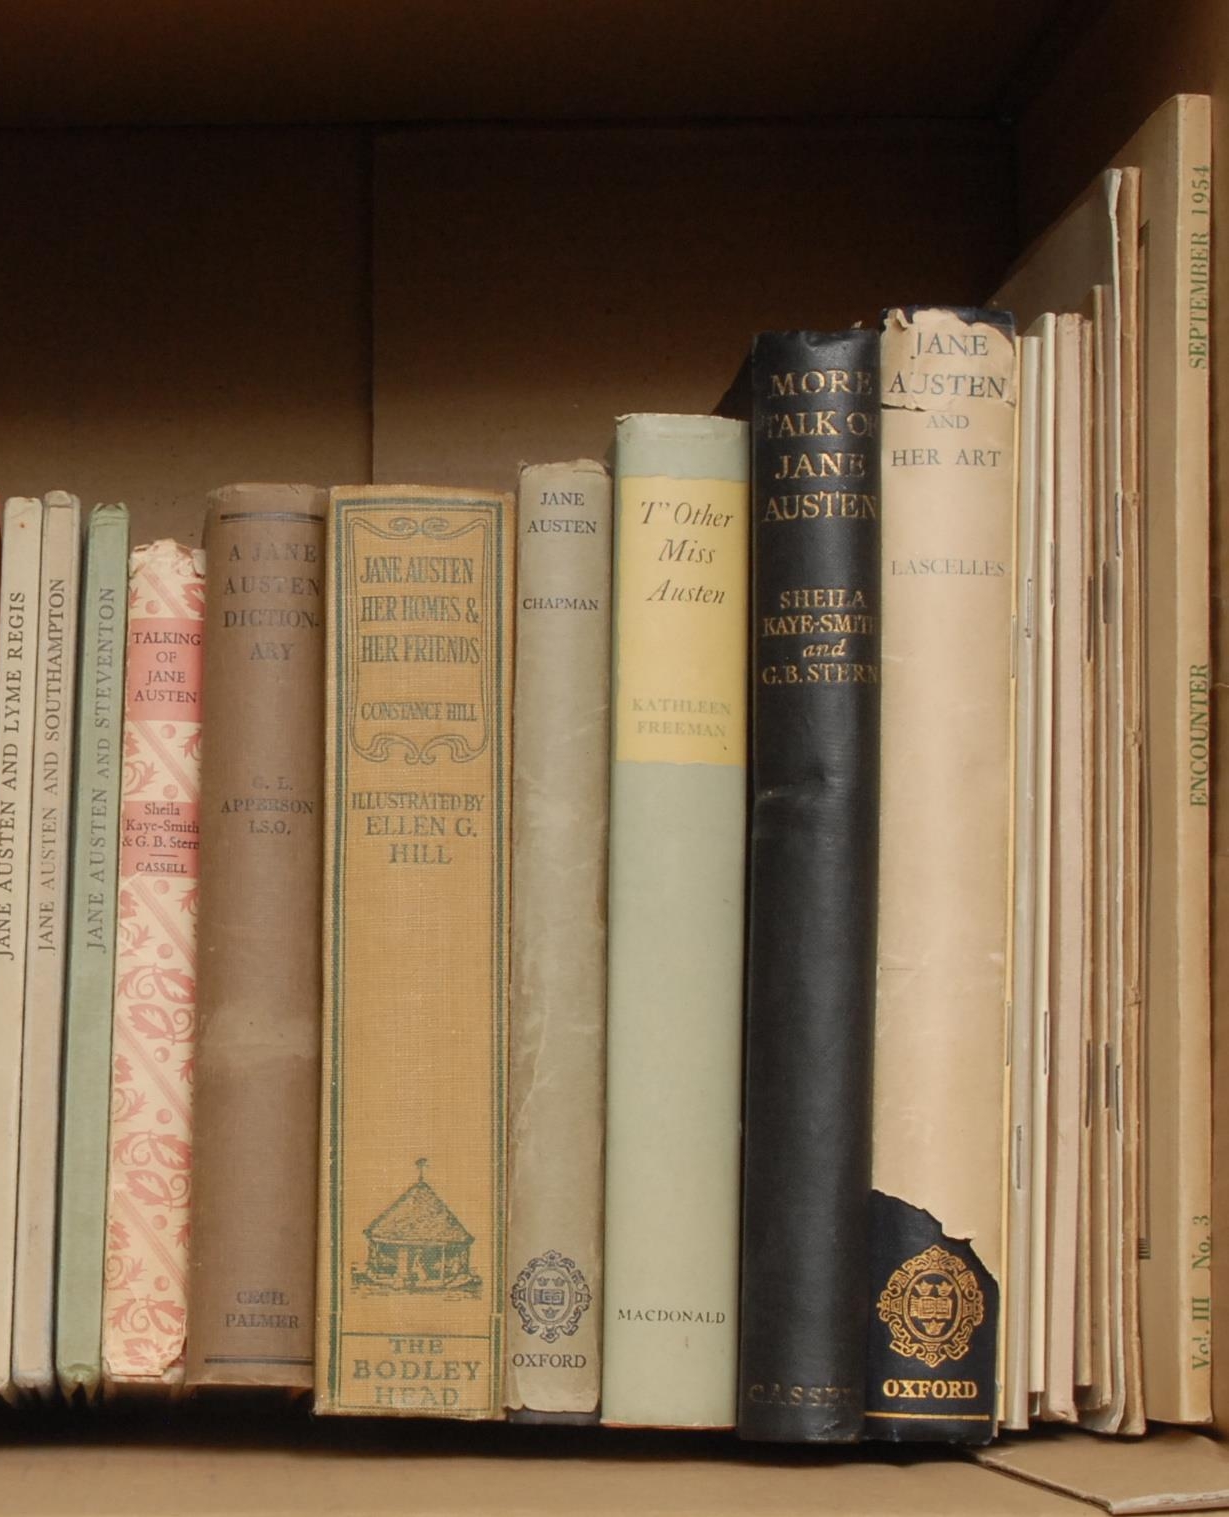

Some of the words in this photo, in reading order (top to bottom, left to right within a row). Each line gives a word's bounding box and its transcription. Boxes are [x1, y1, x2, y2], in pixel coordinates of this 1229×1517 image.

[1191, 164, 1209, 217] 1954
[1188, 231, 1209, 370] SEPTEMBER
[910, 332, 988, 360] JANE
[768, 370, 872, 398] MORE
[926, 414, 969, 430] AND
[775, 452, 866, 479] JANE
[891, 448, 941, 467] HER
[955, 450, 1001, 468] ART
[540, 492, 584, 506] JANE
[762, 491, 877, 522] AUSTEN
[527, 519, 597, 533] AUSTEN
[229, 544, 241, 562] A
[251, 542, 317, 563] JANE
[658, 538, 716, 564] Miss
[360, 557, 402, 584] JANE
[405, 557, 474, 584] AUSTEN
[891, 559, 1004, 577] LASCELLES
[224, 577, 320, 596] AUSTEN
[646, 579, 726, 604] Austen
[523, 598, 599, 610] CHAPMAN
[780, 589, 867, 609] SHEILA
[361, 596, 398, 622] HER
[402, 596, 461, 622] HOMES
[466, 598, 479, 624] &
[9, 591, 25, 659] REGIS
[132, 632, 201, 646] TALKING
[803, 638, 847, 658] and
[45, 579, 65, 741] SOUTHAMPTON
[95, 588, 114, 729] STEVENTON
[156, 651, 177, 664] OF
[250, 643, 294, 661] ARY
[361, 635, 399, 663] HER
[403, 636, 481, 665] FRIENDS
[146, 671, 185, 685] JANE
[4, 670, 22, 733] LYME
[134, 690, 197, 704] AUSTEN
[631, 698, 732, 715] KATHLEEN
[361, 702, 441, 721] CONSTANCE
[447, 703, 478, 722] HILL
[636, 721, 727, 737] FREEMAN
[1189, 663, 1209, 808] ENCOUNTER
[1, 742, 18, 791] AND
[93, 737, 110, 779] AND
[43, 751, 59, 796] AND
[144, 802, 180, 816] Sheila
[220, 798, 315, 814] APPERSON
[352, 792, 462, 812] ILLUSTRATED
[462, 793, 485, 812] BY
[90, 788, 108, 882] AUSTEN
[366, 816, 446, 836] ELLEN
[455, 818, 478, 838] G.
[40, 807, 57, 893] AUSTEN
[123, 836, 132, 847] &
[389, 844, 453, 865] HILL
[136, 862, 187, 873] CASSELL
[38, 900, 56, 954] JANE
[87, 892, 106, 953] JANE
[1193, 1215, 1211, 1226] 3
[1192, 1236, 1211, 1271] No.
[617, 1309, 726, 1324] MACDONALD
[1191, 1296, 1210, 1321] III
[225, 1314, 300, 1329] PALMER
[389, 1337, 444, 1354] THE
[353, 1359, 482, 1381] BODLEY
[512, 1353, 587, 1369] OXFORD
[375, 1386, 460, 1406] HEAD
[883, 1380, 977, 1400] OXFORD
